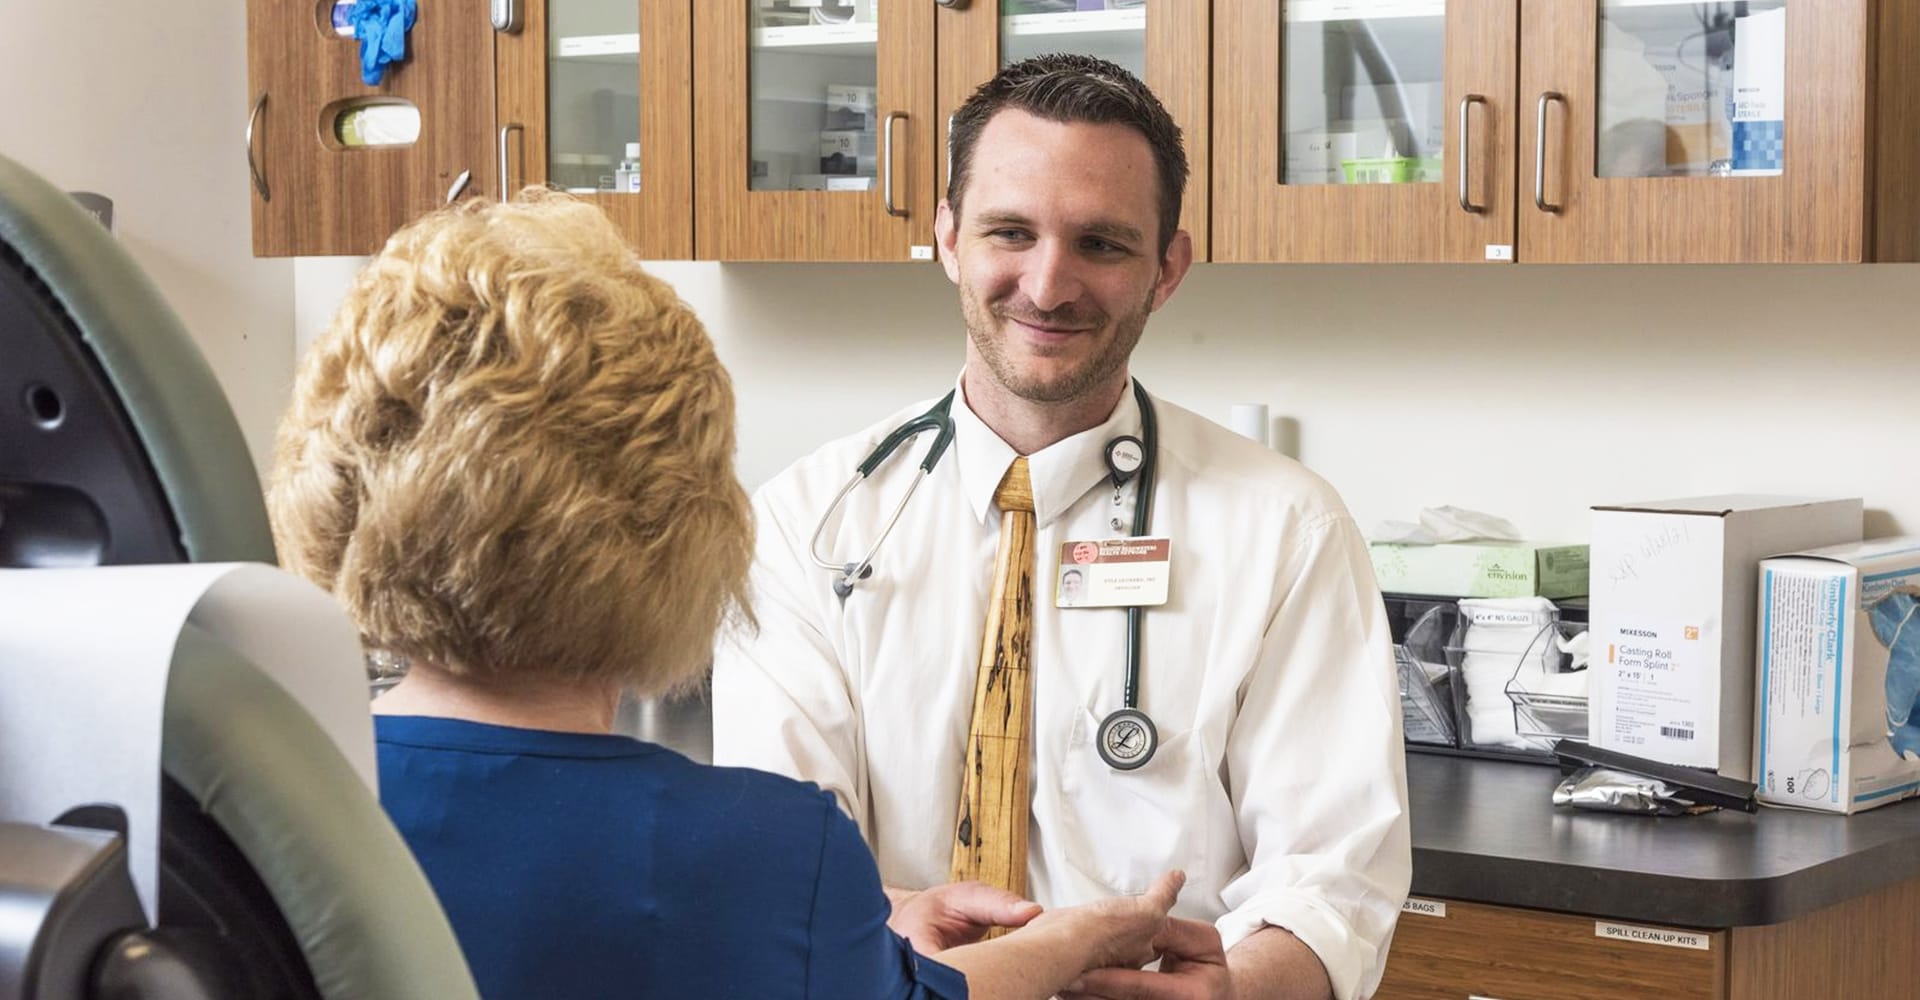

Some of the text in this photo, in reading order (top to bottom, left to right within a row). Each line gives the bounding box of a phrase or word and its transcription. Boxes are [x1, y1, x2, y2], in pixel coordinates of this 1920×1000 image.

[847, 93, 857, 103] 10
[839, 138, 850, 148] 10
[1619, 644, 1672, 659] Casting Roll
[1619, 656, 1641, 667] Form
[1643, 658, 1669, 671] Splint
[1786, 776, 1796, 794] 100
[1412, 902, 1435, 913] BAGS
[1606, 927, 1697, 946] SPILL CLEAN-UP KITS
